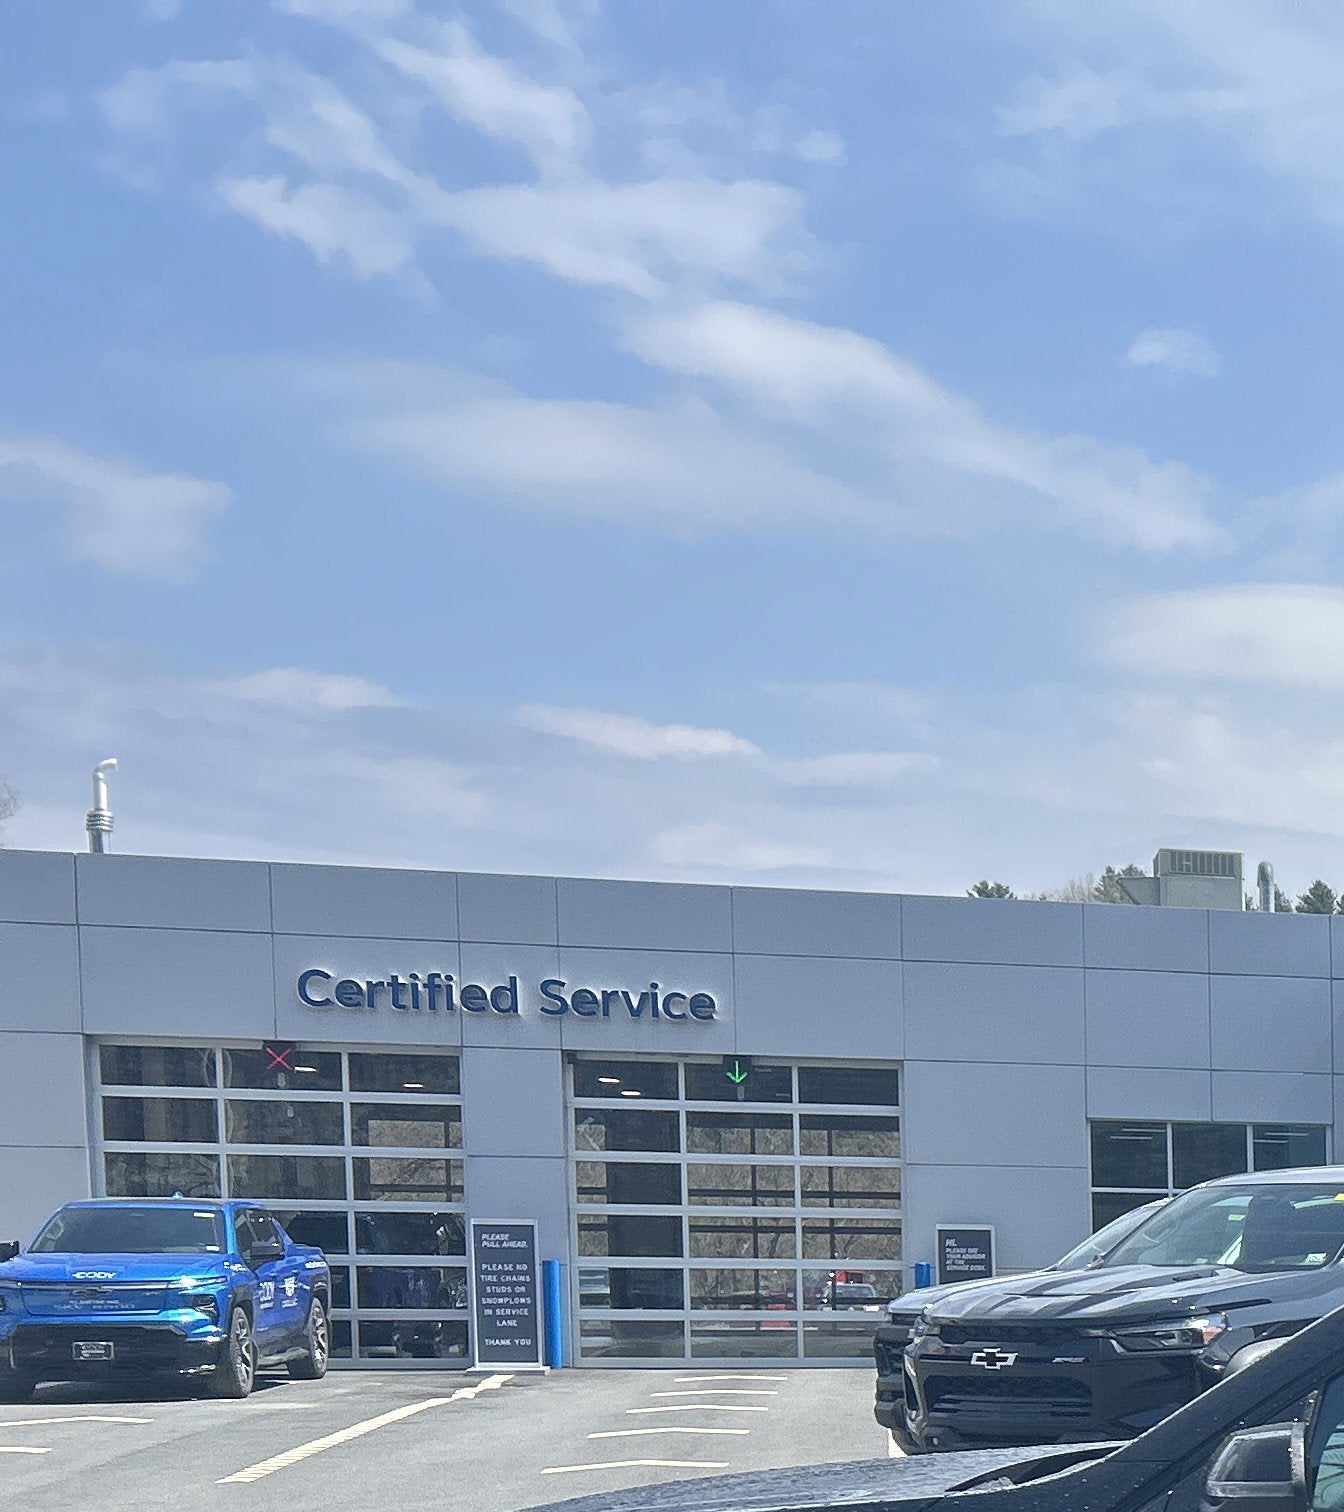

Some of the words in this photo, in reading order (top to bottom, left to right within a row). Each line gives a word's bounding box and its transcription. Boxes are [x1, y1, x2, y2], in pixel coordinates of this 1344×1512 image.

[297, 968, 519, 1014] Certified
[539, 978, 717, 1021] Service
[481, 1233, 510, 1241] PLEASE
[481, 1240, 501, 1248] PULL
[481, 1263, 514, 1271] PLEASE
[515, 1263, 528, 1271] NO
[480, 1274, 498, 1282] TIRE
[500, 1274, 531, 1282] CHAINS
[485, 1285, 512, 1293] STUDS
[514, 1285, 526, 1293] OR
[481, 1297, 532, 1305] SNOWPLOWS
[483, 1308, 493, 1316] IN
[495, 1308, 529, 1316] SERVICE
[496, 1319, 518, 1327] LANE
[484, 1338, 512, 1346] THANK
[514, 1338, 532, 1346] YOU
